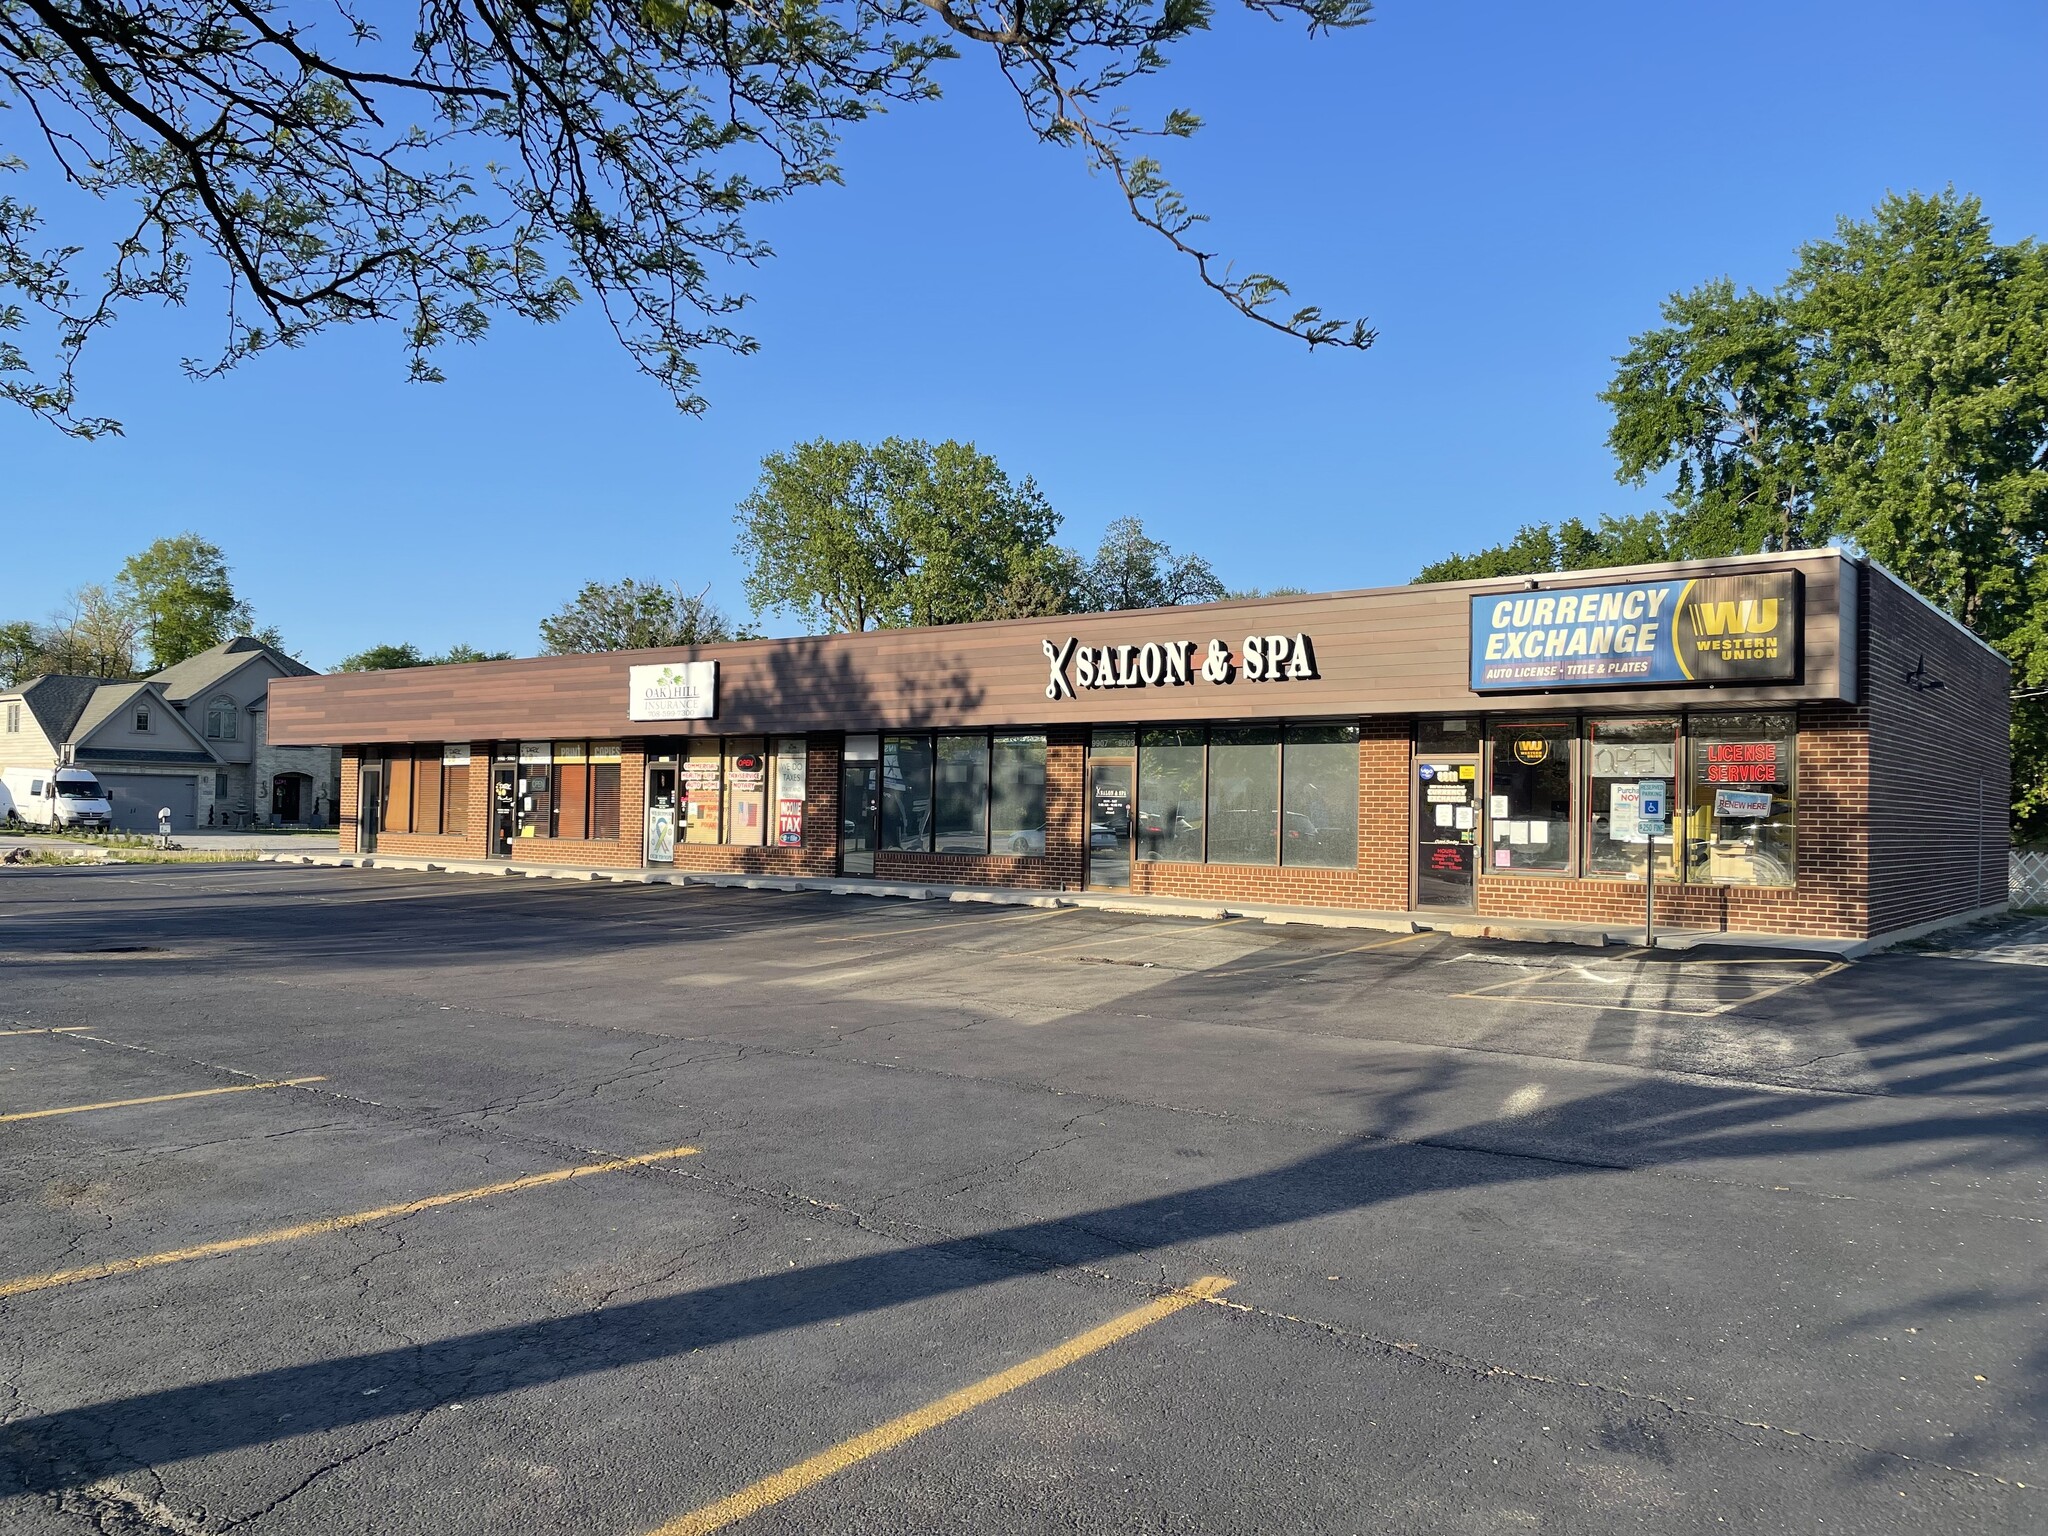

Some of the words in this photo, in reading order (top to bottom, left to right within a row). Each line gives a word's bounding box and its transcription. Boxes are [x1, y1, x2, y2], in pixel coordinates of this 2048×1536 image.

[1491, 588, 1670, 629] CURRENCY
[1484, 622, 1659, 661] EXCHANGE
[1696, 636, 1778, 651] WESTERN
[1076, 641, 1191, 687] SALON
[1201, 638, 1229, 683] &
[1242, 632, 1314, 680] SPA
[1721, 648, 1778, 661] UNION
[1486, 667, 1512, 680] AUTO
[1514, 665, 1557, 678] LICENSE
[1566, 663, 1595, 676] TITLE
[1596, 662, 1606, 674] &
[1608, 661, 1648, 674] PLATES
[645, 687, 667, 698] OAK
[674, 686, 700, 697] HILL
[644, 700, 698, 710] INSURANCE
[594, 746, 621, 756] COPIES
[1708, 744, 1776, 761] LICENSE
[781, 762, 790, 770] WE
[792, 762, 802, 770] DO
[1595, 746, 1672, 773] OPEN
[783, 773, 801, 782] TAXES
[1708, 764, 1776, 781] SERVICE
[1617, 786, 1639, 794] Purcha
[1719, 799, 1745, 809] RENEW
[781, 816, 801, 832] TAX
[1654, 824, 1664, 832] FINE
